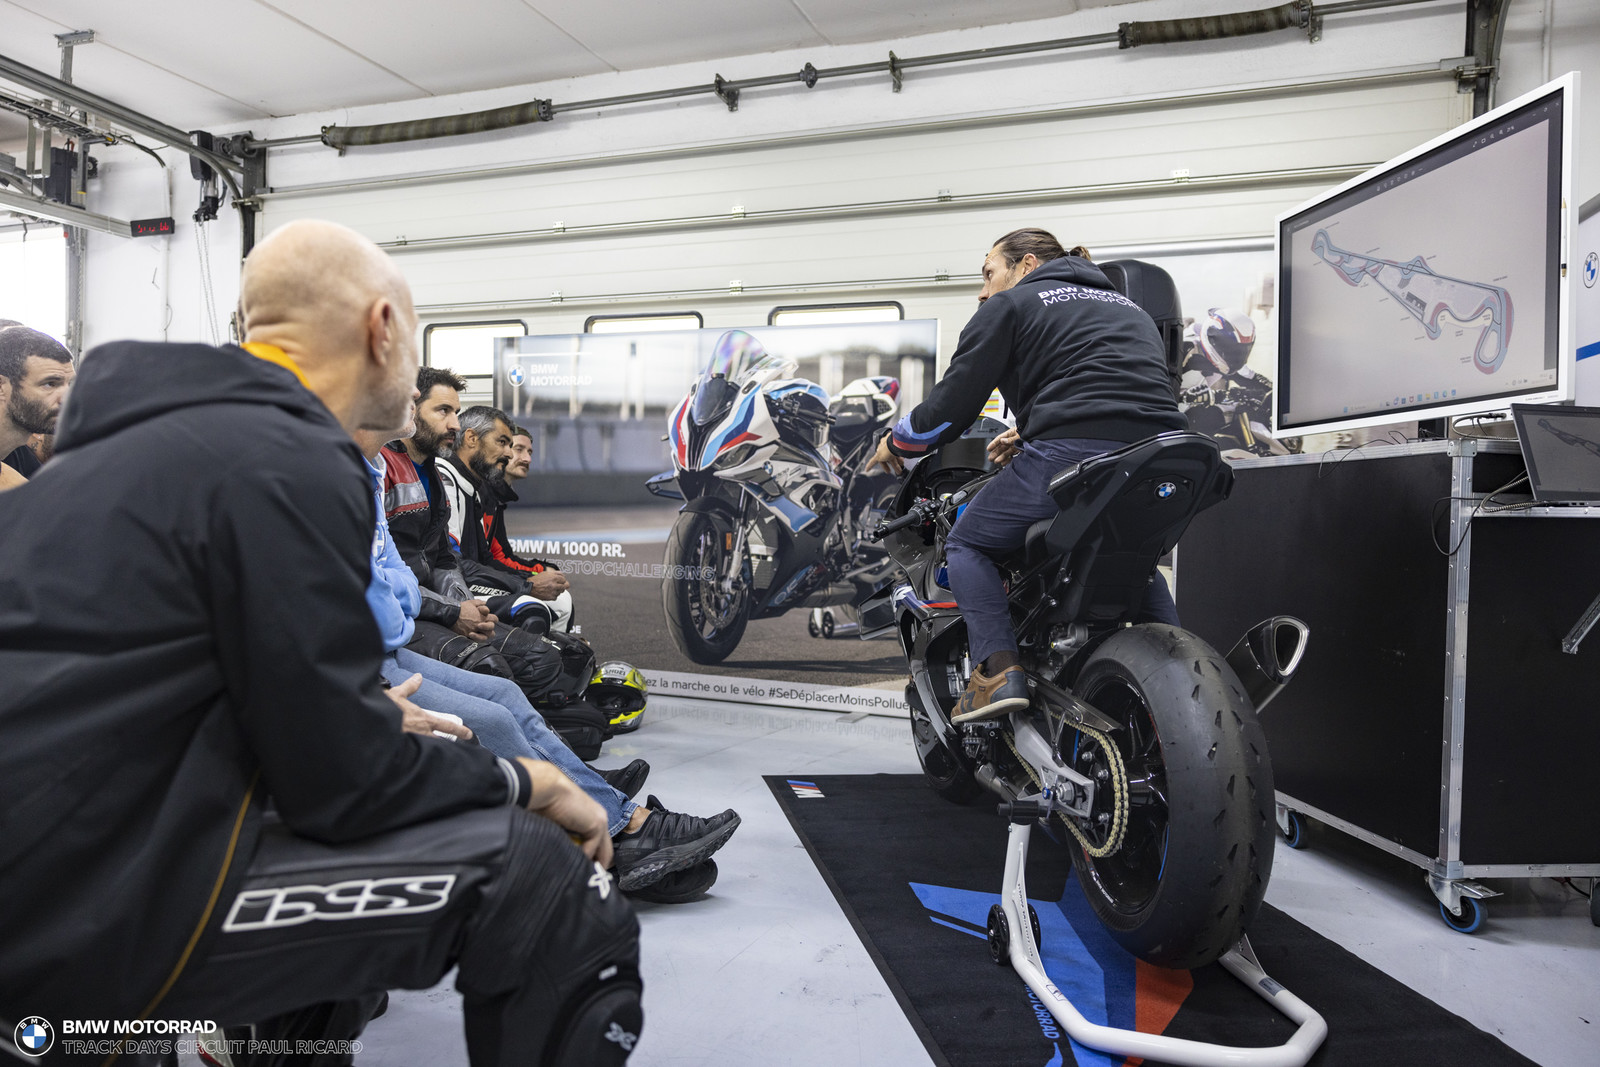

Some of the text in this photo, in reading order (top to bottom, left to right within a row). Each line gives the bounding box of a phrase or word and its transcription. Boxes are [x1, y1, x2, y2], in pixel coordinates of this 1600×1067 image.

[1038, 287, 1077, 299] BMW
[530, 364, 559, 374] BMW
[530, 375, 593, 386] MOTORRAD
[508, 538, 626, 558] BMW M 1000 RR.
[660, 677, 669, 688] la
[671, 680, 710, 692] marche
[713, 684, 727, 694] ou
[730, 684, 739, 695] le
[742, 685, 765, 697] vélo
[768, 687, 910, 710] #SeDéplacerMoinsPollue
